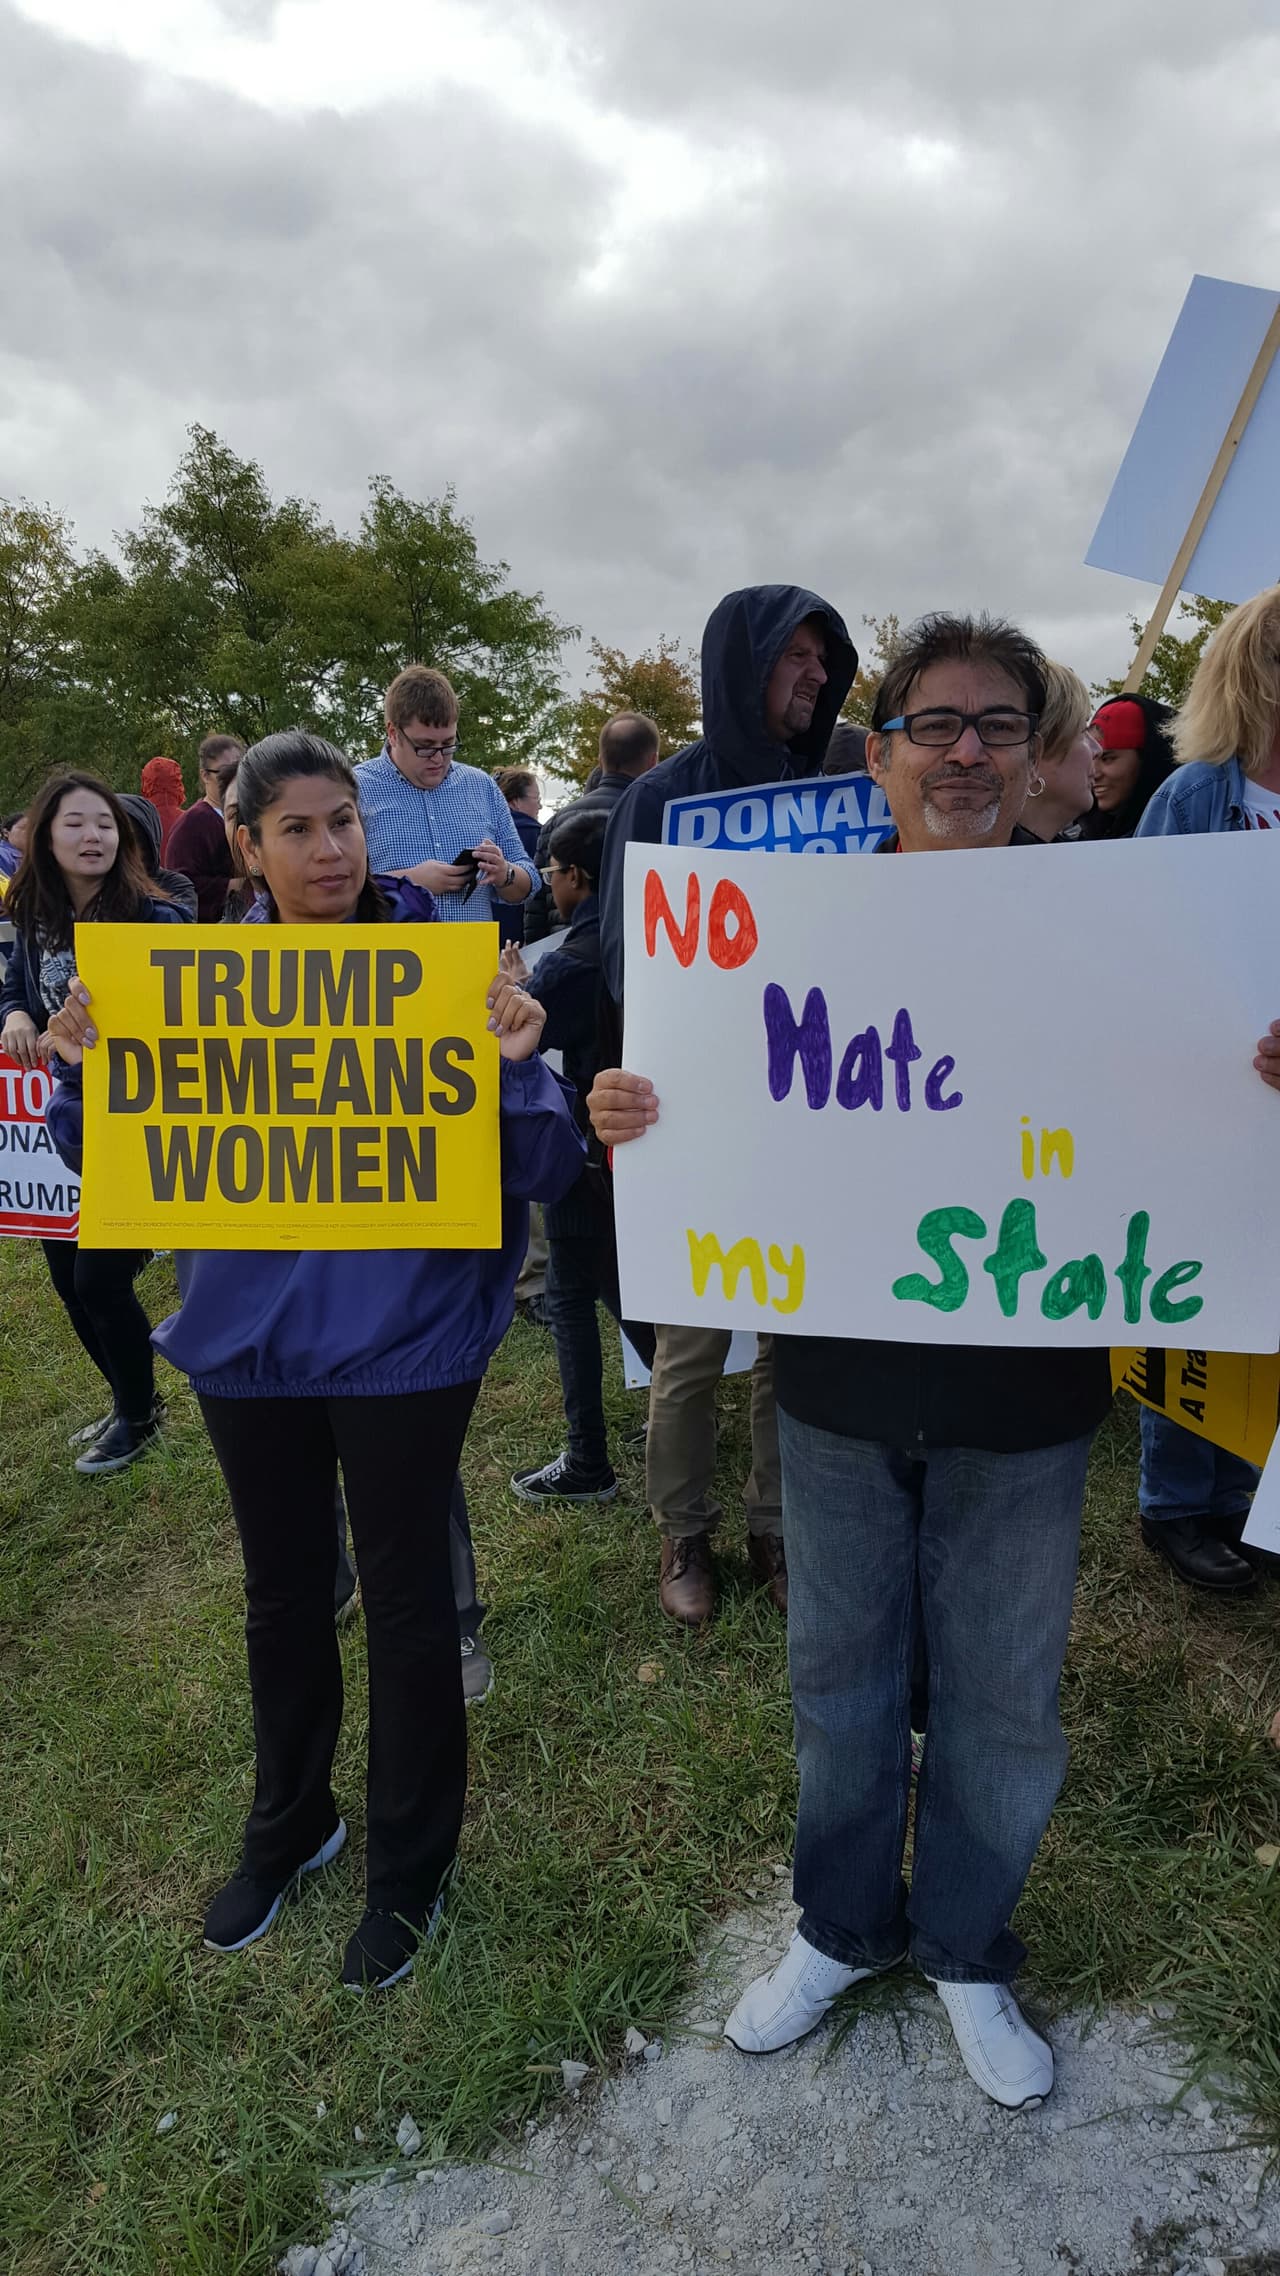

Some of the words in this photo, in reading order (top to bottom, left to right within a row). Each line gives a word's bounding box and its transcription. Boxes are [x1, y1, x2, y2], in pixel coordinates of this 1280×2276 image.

[677, 785, 895, 848] DONAL
[644, 869, 758, 969] NO
[150, 949, 423, 1027] TRUMP
[0, 1069, 56, 1117] TO
[107, 1037, 477, 1116] DEMEANS
[144, 1125, 438, 1204] WOMEN
[1020, 1116, 1075, 1181] in
[0, 1180, 81, 1212] RUMP
[687, 1228, 806, 1315] my
[891, 1197, 1204, 1325] State
[1181, 1350, 1207, 1390] Tra
